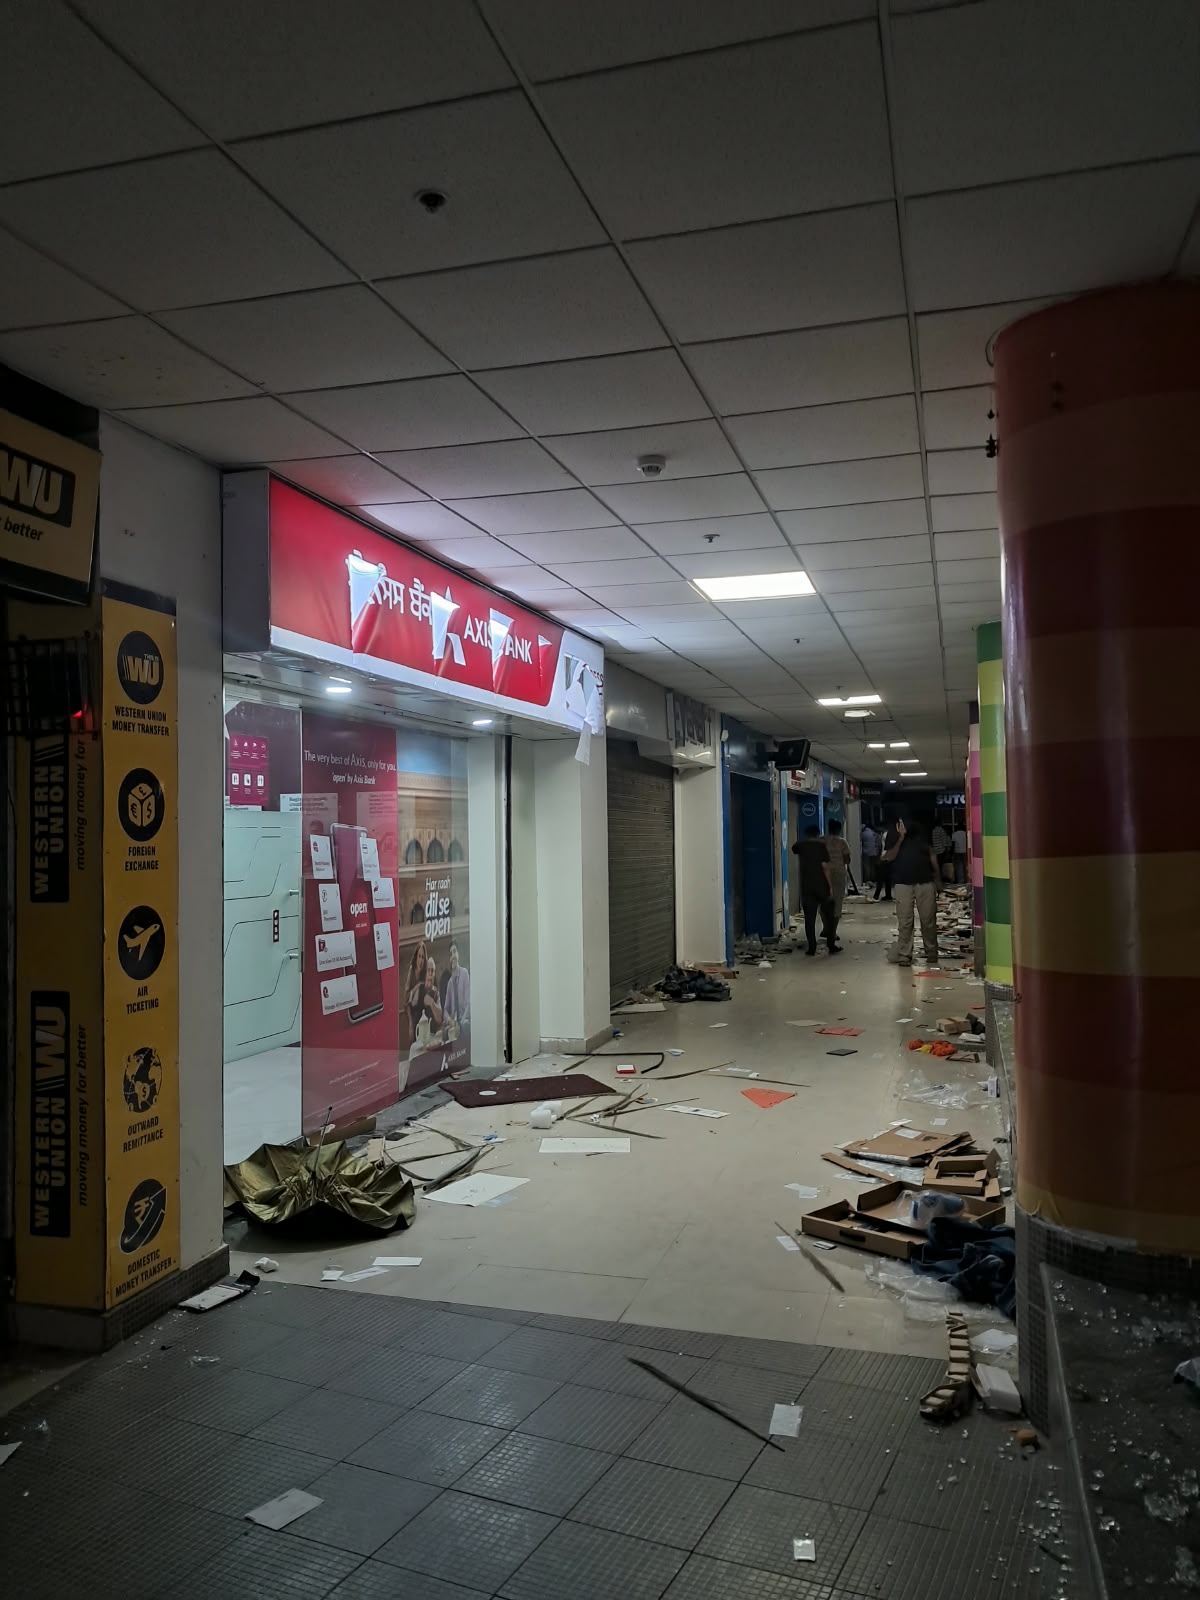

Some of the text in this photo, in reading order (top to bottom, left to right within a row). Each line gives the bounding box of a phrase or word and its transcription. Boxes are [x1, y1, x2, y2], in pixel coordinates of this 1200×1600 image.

[4, 516, 43, 541] better
[502, 634, 533, 665] ANK
[124, 655, 160, 686] WU
[114, 705, 167, 722] WESTERN UNION
[112, 719, 170, 736] MONEY TRANSFER
[304, 750, 316, 762] The
[317, 755, 330, 766] very
[331, 754, 344, 765] best
[344, 756, 351, 765] of
[351, 753, 367, 769] Axis,
[367, 760, 380, 771] only
[386, 762, 397, 772] you.
[347, 773, 354, 783] by
[353, 773, 364, 783] Axis
[364, 774, 376, 785] Bank
[49, 765, 65, 854] UNION
[74, 740, 87, 871] moving money for
[33, 765, 49, 897] WESTERN
[128, 846, 156, 857] FOREIGN
[125, 860, 159, 871] EXCHANGE
[426, 878, 437, 891] Har
[350, 902, 368, 917] open
[425, 892, 450, 917] dil se
[425, 917, 450, 943] open
[137, 986, 149, 998] AIR
[126, 998, 159, 1014] TICKETING
[35, 1005, 66, 1088] WU
[76, 1024, 90, 1206] moving money for better
[127, 1116, 159, 1136] OUTWARD
[50, 1097, 66, 1188] UNION
[123, 1129, 163, 1152] REMITTANCE
[34, 1096, 50, 1228] WESTERN
[127, 1248, 160, 1275] DOMESTIC
[115, 1257, 172, 1297] MONEY TRANSFER
